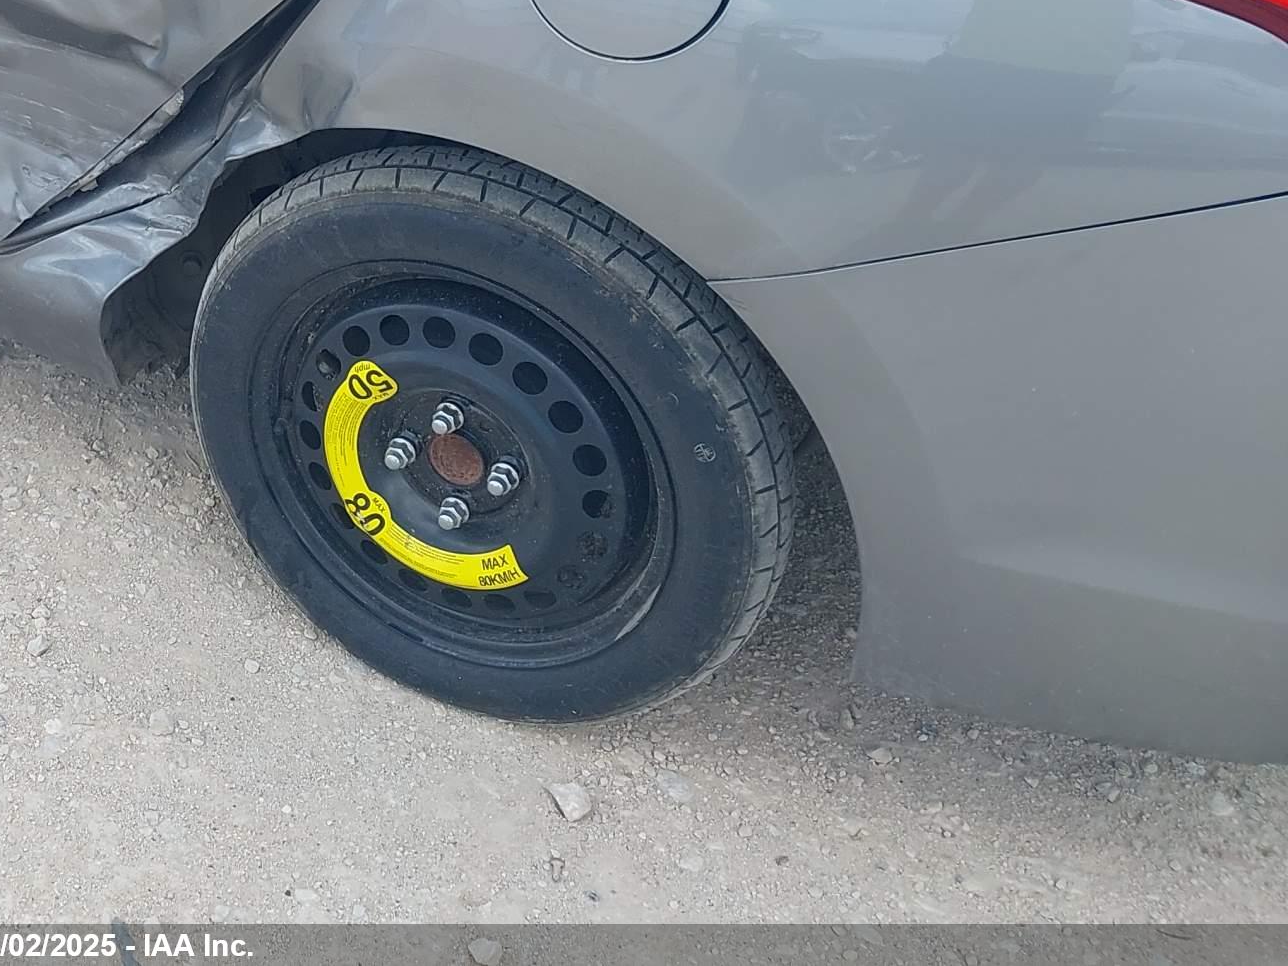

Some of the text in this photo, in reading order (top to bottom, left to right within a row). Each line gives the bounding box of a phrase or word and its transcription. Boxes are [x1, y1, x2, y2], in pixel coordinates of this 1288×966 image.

[348, 369, 394, 400] 50
[344, 492, 386, 537] 80
[372, 497, 386, 513] MAX
[481, 553, 509, 571] MAX
[478, 566, 521, 587] 80KM/H
